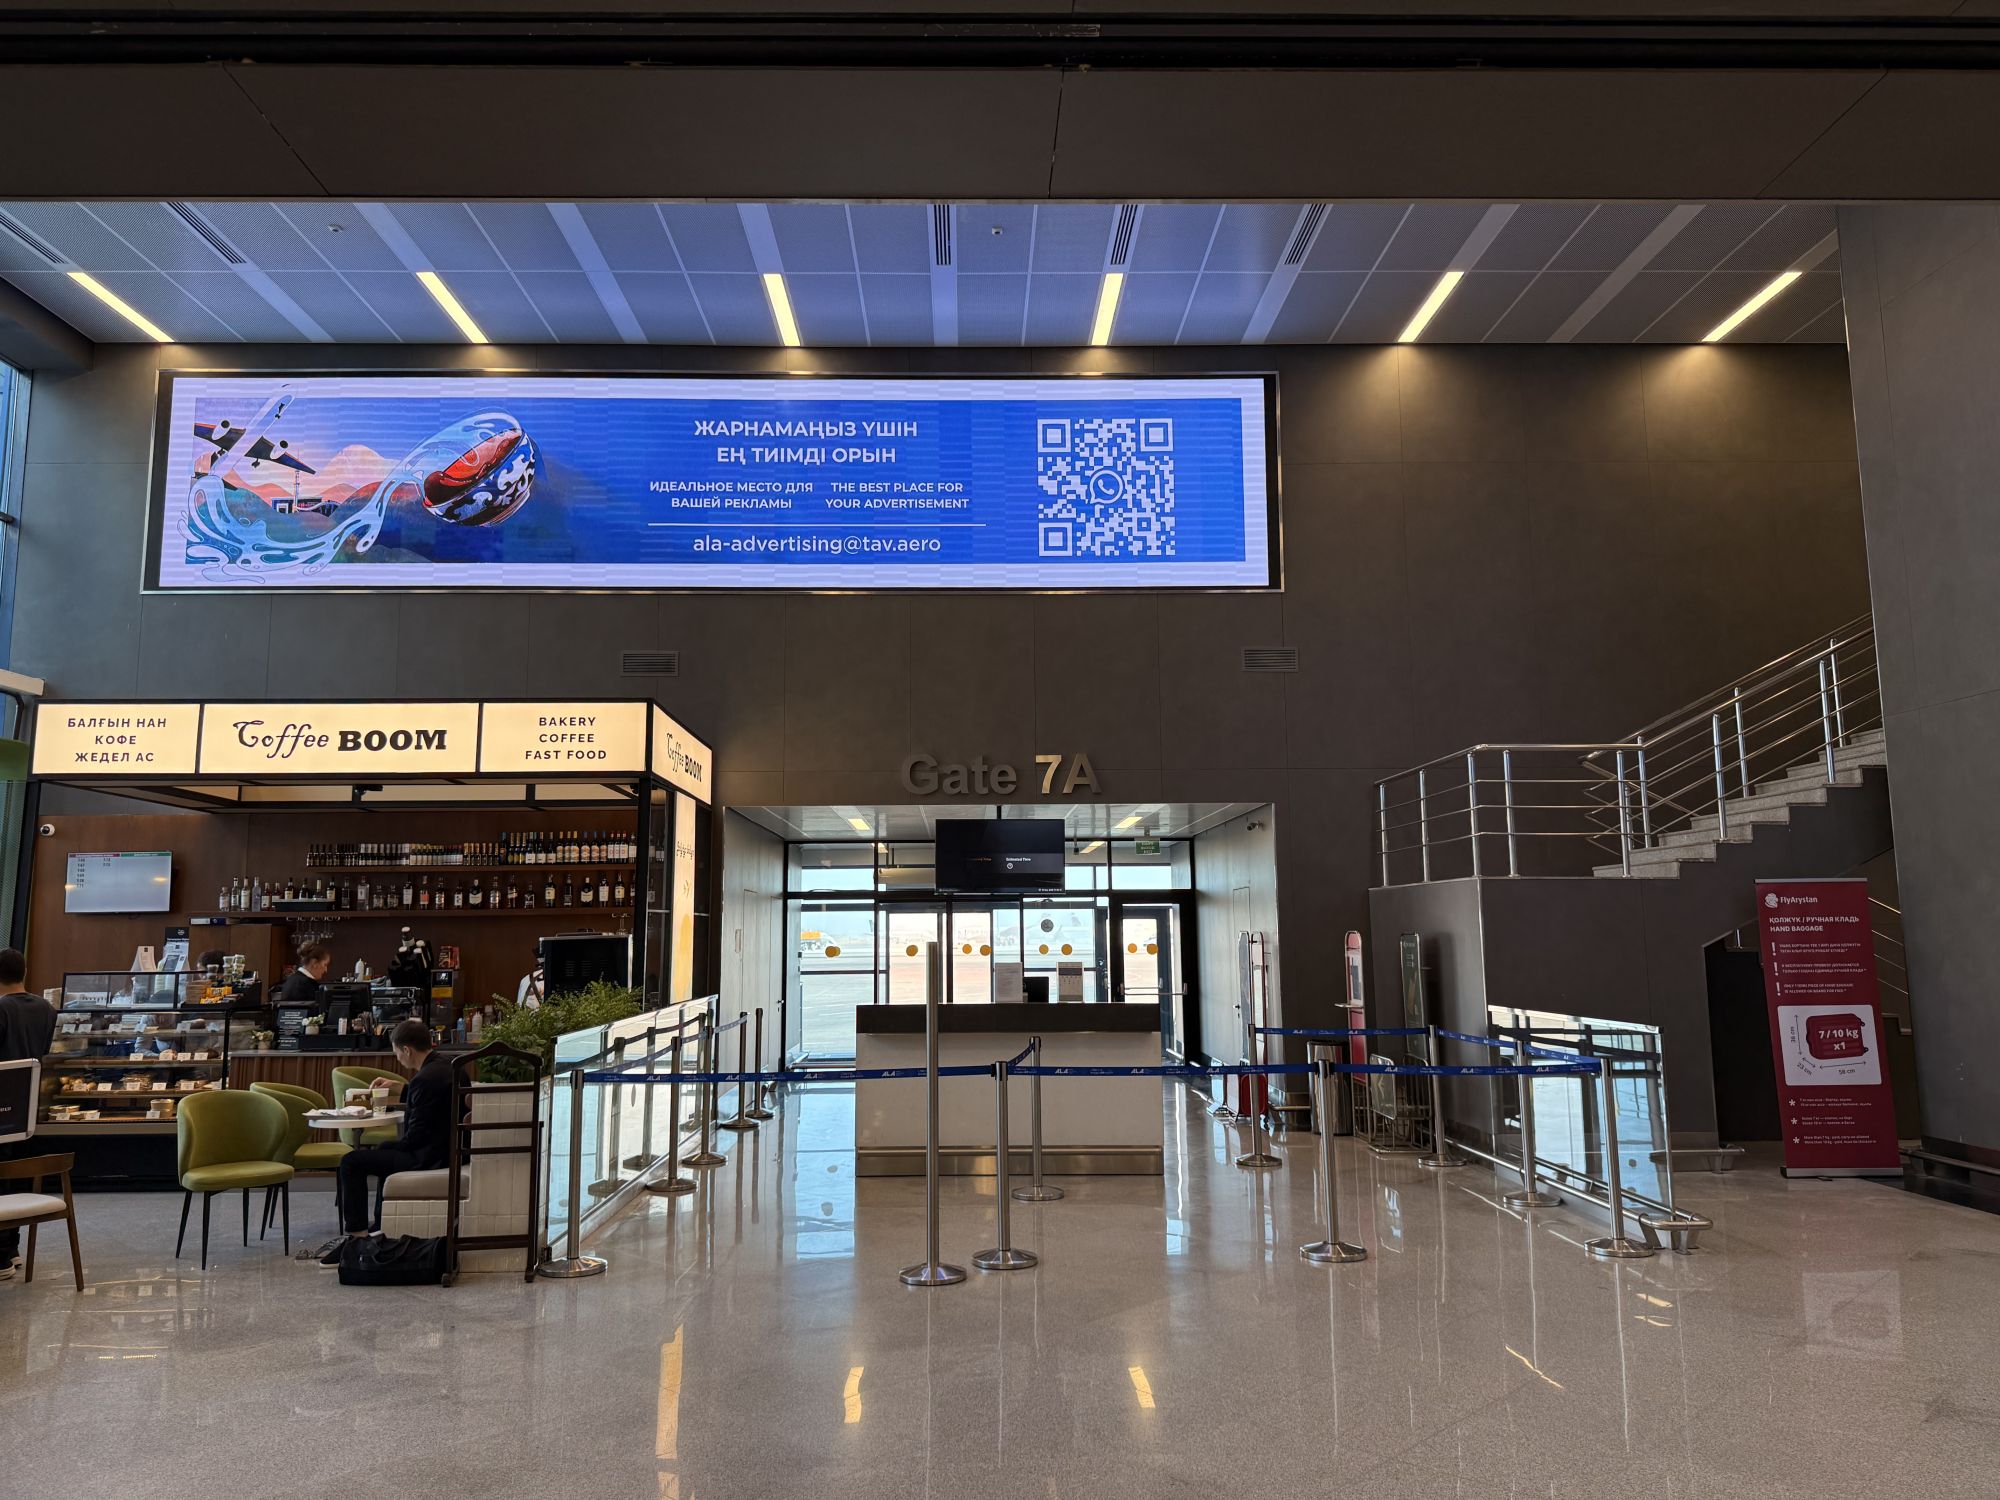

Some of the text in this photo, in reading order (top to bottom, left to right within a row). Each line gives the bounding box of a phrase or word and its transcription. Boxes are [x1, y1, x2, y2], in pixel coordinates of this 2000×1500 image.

[694, 420, 918, 439] ЖАРНАМАҢЫЗ ҮШІН
[717, 447, 896, 466] ЕҢ ТИІМДІ ОРЫН
[650, 481, 814, 494] ИДЕАЛЬНОЕ МЕСТО ДЛЯ
[831, 482, 964, 493] THE BEST PLACE FOR
[671, 497, 793, 509] ВАШЕЙ РЕКЛАМЫ
[825, 498, 970, 509] YOUR ADVERTISEMENT
[693, 535, 941, 554] ala-advertising@tav.aero
[67, 718, 167, 728] БАЛҒЫН НАН
[538, 716, 597, 727] BAKERY
[95, 735, 137, 745] КОФЕ
[232, 719, 448, 759] Coffee BOOM
[538, 733, 595, 743] COFFEE
[75, 752, 155, 763] ЖЕДЕЛ АС
[525, 749, 607, 760] FAST FOOD
[684, 754, 702, 782] BOOM
[902, 753, 1103, 795] Gate 7A
[1780, 896, 1818, 905] FlyArystan
[1818, 1030, 1825, 1039] 7
[1832, 1029, 1844, 1038] 10
[1846, 1028, 1859, 1039] kg
